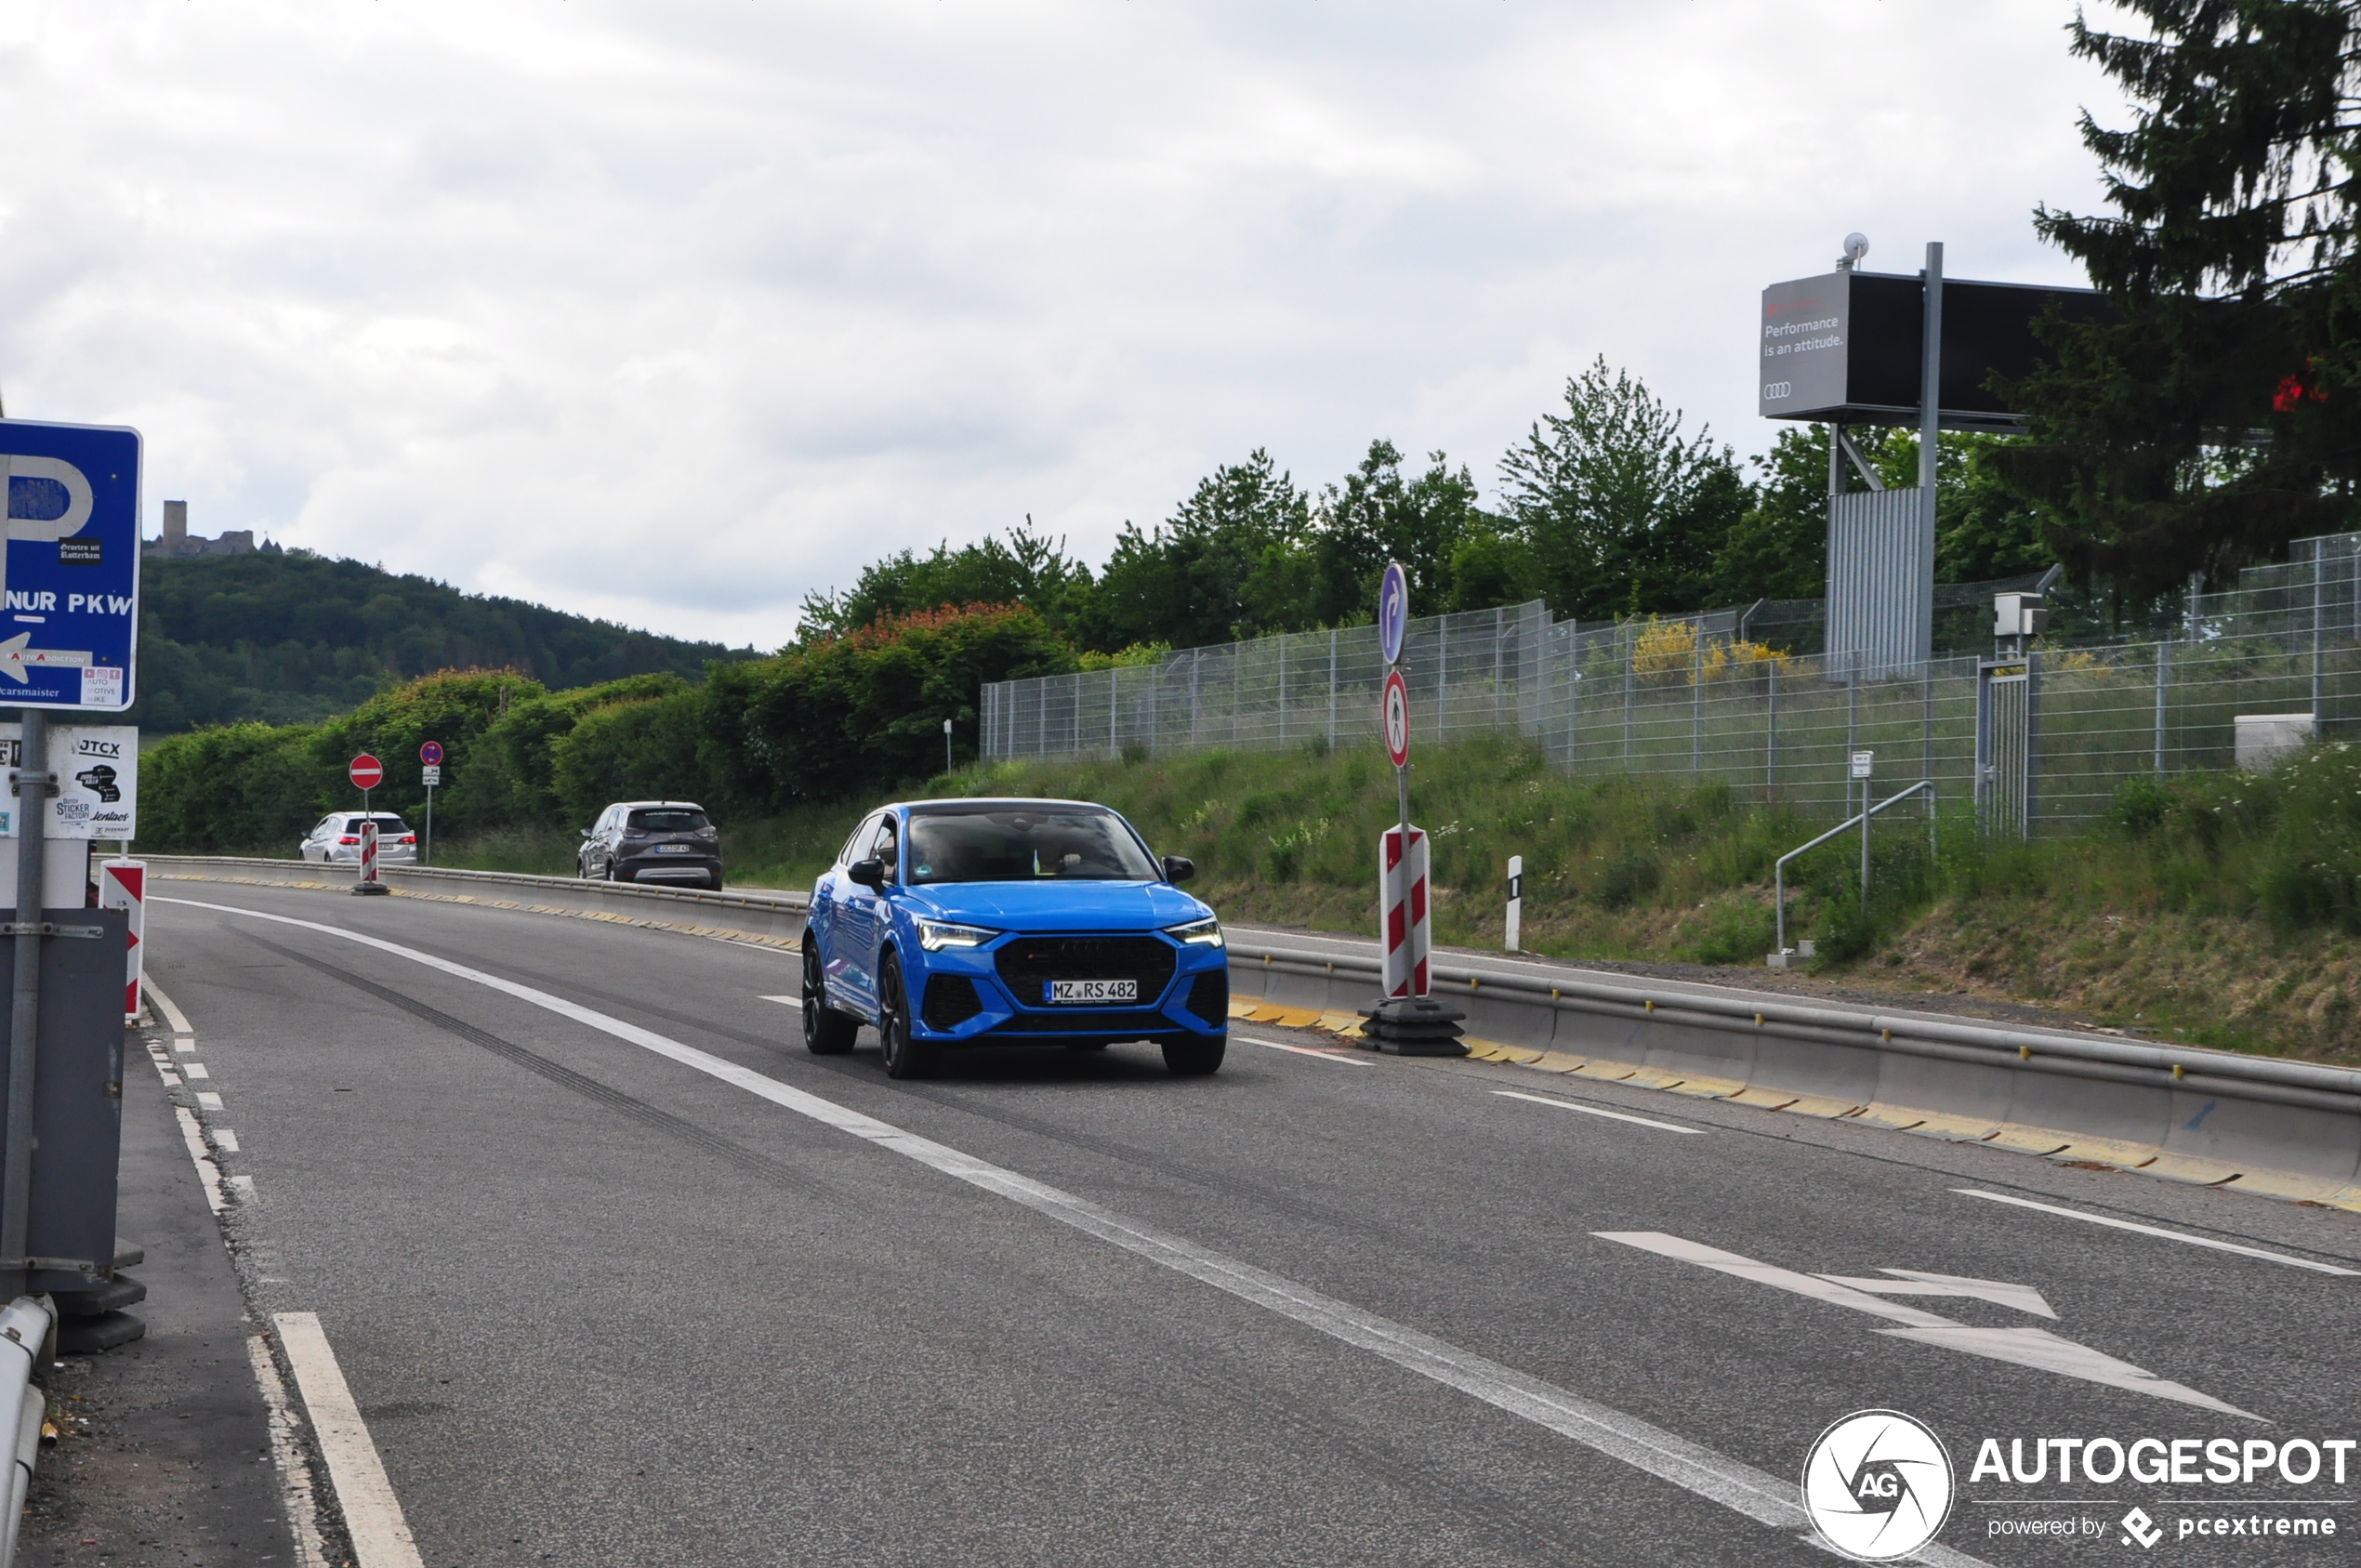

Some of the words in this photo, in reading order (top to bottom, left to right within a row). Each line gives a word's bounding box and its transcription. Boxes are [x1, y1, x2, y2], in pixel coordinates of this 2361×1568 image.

[1765, 317, 1839, 337] Performance
[1764, 345, 1774, 357] is
[1776, 344, 1791, 355] an
[1794, 334, 1843, 352] attitude.
[0, 454, 94, 611] P
[59, 551, 100, 560] Rotterdam
[5, 589, 56, 613] NUR
[68, 593, 133, 615] PKW
[79, 739, 121, 755] JTCX
[57, 802, 89, 816] STICKER
[1053, 983, 1074, 998] MZ
[1084, 982, 1104, 998] RS
[1107, 982, 1136, 997] 482
